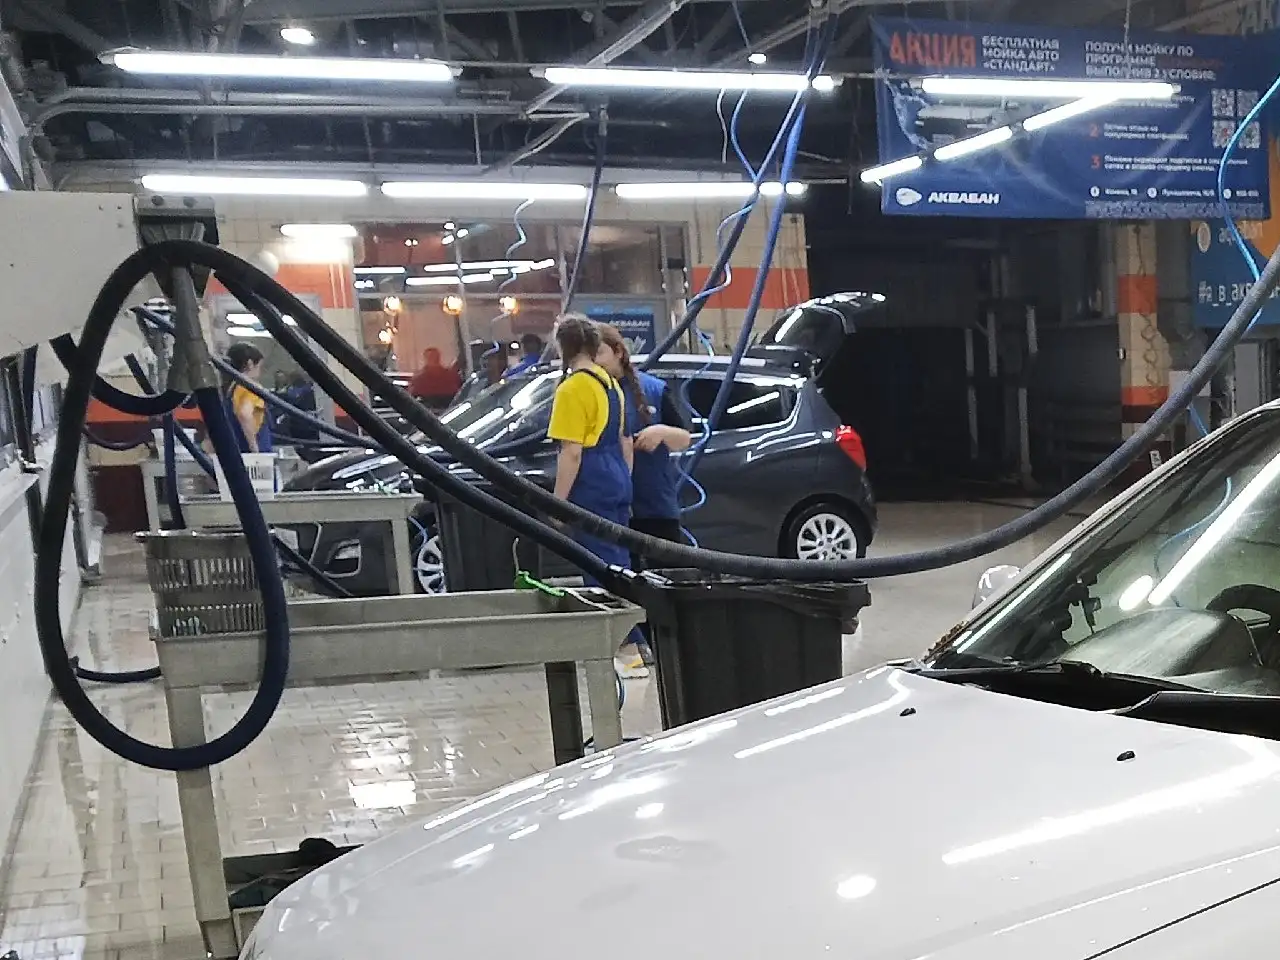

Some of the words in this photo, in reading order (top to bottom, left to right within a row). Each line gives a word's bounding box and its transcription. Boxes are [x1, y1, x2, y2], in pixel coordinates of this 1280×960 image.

[889, 31, 977, 68] АКЦИЯ
[982, 35, 1060, 50] БЕСПЛАТНАЯ
[982, 47, 1026, 60] МОЙКА
[1029, 50, 1060, 61] АВТО
[1178, 45, 1195, 57] ПО
[928, 191, 1000, 205] АКВАБАН
